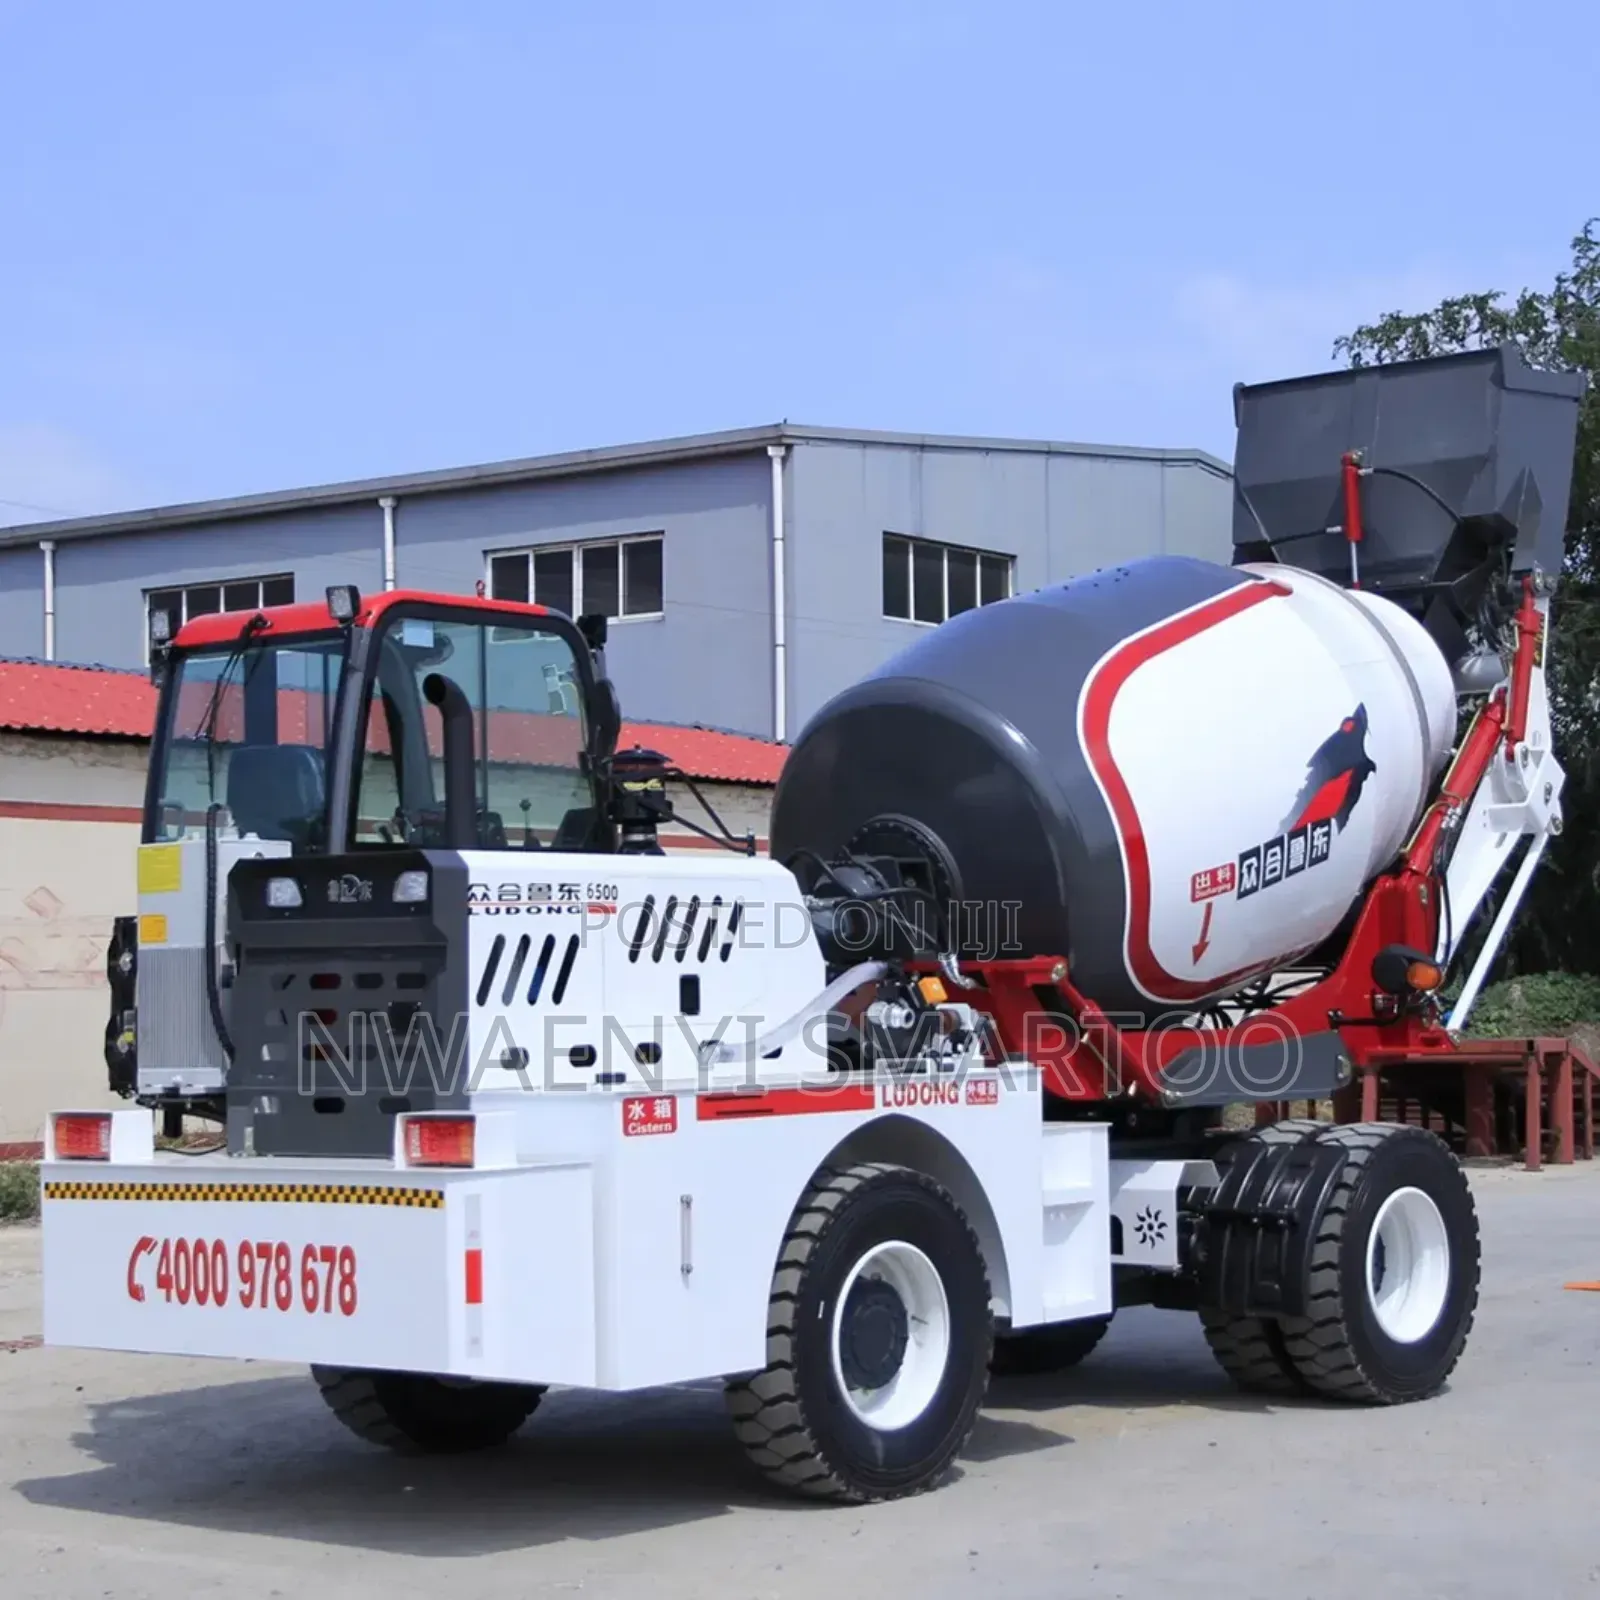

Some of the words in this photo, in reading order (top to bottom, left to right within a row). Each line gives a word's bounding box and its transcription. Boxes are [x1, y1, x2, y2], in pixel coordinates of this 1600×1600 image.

[1240, 826, 1329, 893] 众合鲁东
[586, 882, 618, 900] 6500
[467, 905, 582, 916] LUDONG
[882, 1081, 960, 1107] LUDONG
[627, 1099, 672, 1120] 水箱
[627, 1121, 673, 1134] Cistern
[156, 1237, 229, 1307] 4000
[238, 1240, 293, 1312] 978
[301, 1243, 358, 1317] 678
